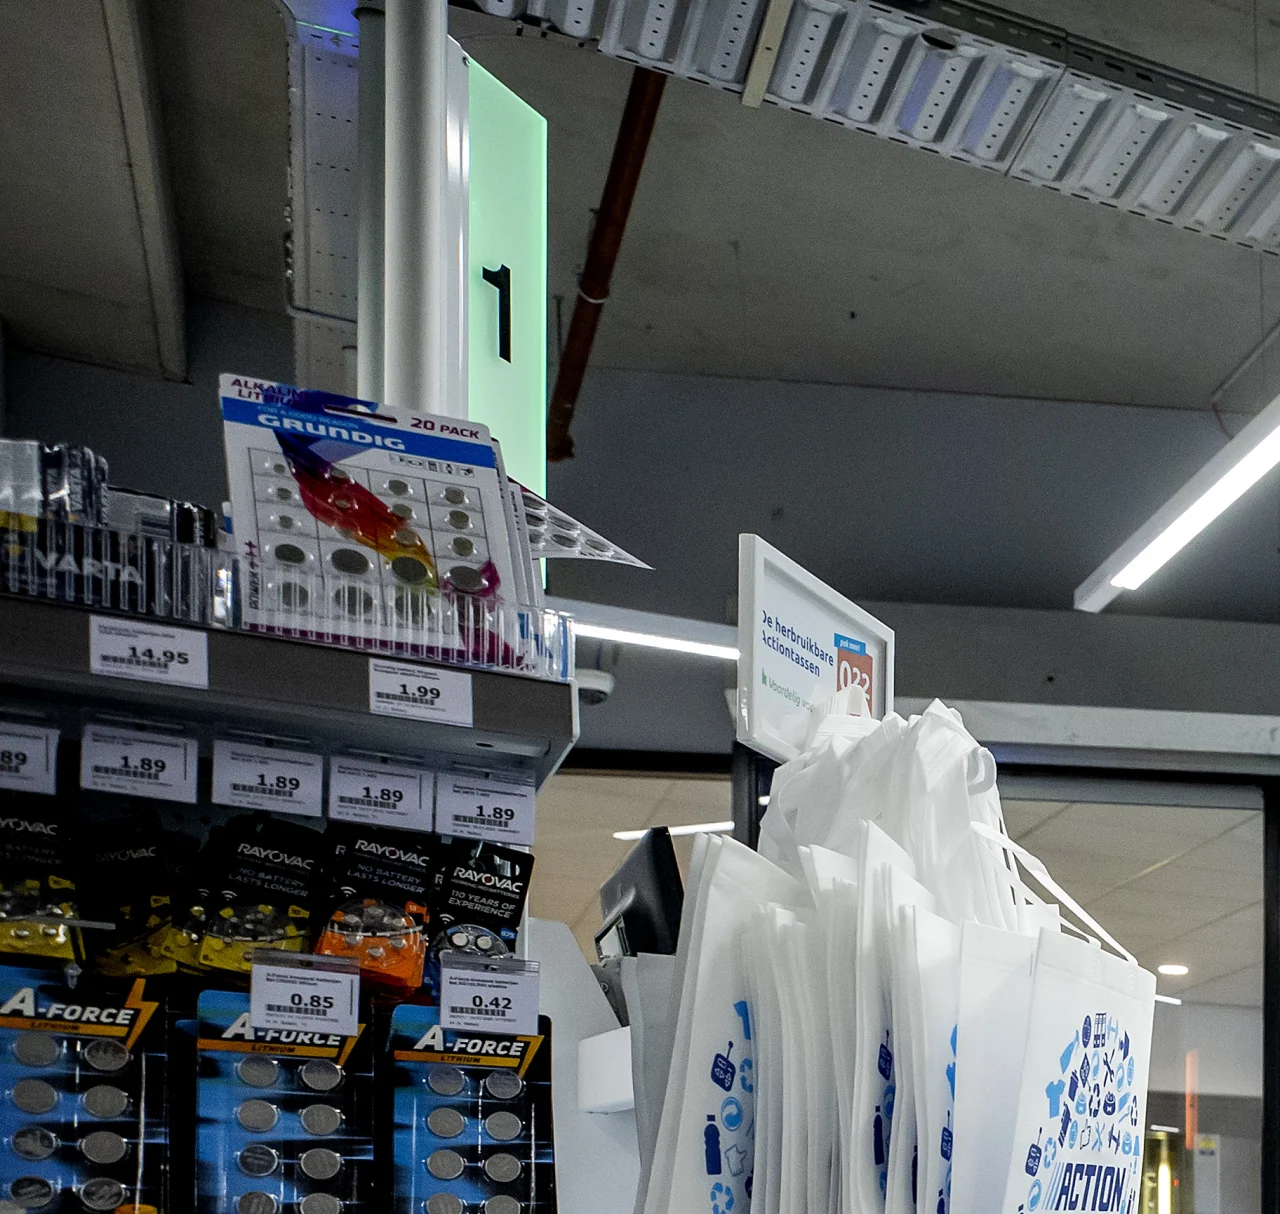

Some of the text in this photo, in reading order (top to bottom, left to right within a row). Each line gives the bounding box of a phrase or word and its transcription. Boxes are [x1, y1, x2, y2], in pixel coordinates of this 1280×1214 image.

[482, 263, 511, 363] 1
[257, 413, 406, 451] GRUNDIG
[411, 417, 480, 440] 20 PACK
[35, 549, 143, 586] VARTA
[776, 617, 834, 667] herbruikbare
[128, 646, 190, 666] 14.95
[400, 683, 440, 699] 1.99
[769, 677, 801, 707] Voordelig
[120, 755, 166, 773] 1.89
[257, 773, 300, 791] 1.89
[362, 786, 404, 803] 1.89
[476, 805, 515, 821] 1.89
[238, 843, 314, 870] RAYOVAC
[355, 840, 430, 867] RAYOVAC
[347, 871, 424, 893] LASTS LONGER
[357, 864, 421, 885] NO BATTERY
[453, 867, 523, 893] RAYOVAC
[448, 897, 514, 918] EXPERIENCE
[451, 889, 466, 898] 110
[468, 893, 499, 907] YEARS
[1, 988, 134, 1025] A-FORCE
[290, 993, 334, 1009] 0.85
[472, 995, 512, 1010] 0.42
[414, 1024, 525, 1056] A-FORCE
[440, 1055, 482, 1064] LITHIUM
[1057, 1163, 1126, 1212] ACTION
